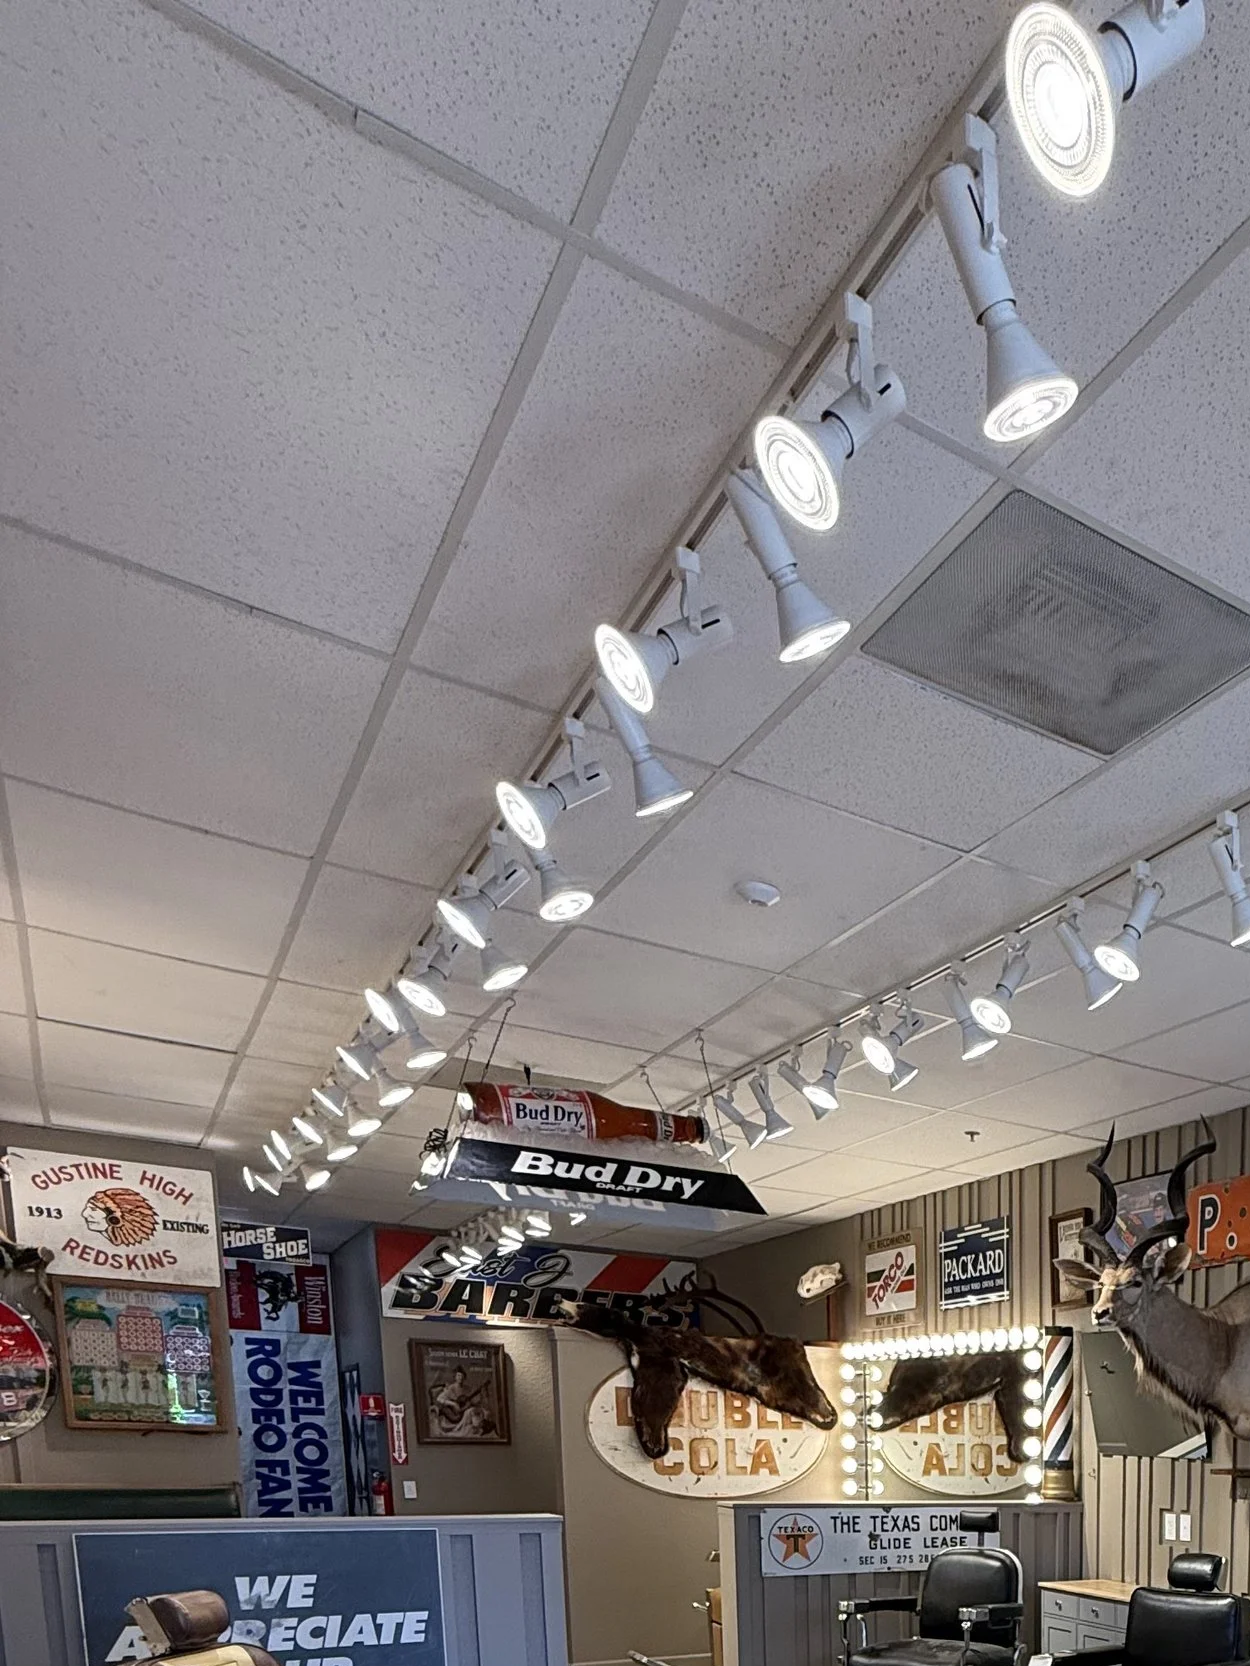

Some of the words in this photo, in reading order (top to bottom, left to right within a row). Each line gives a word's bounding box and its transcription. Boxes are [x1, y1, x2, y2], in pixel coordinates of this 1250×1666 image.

[515, 1102, 549, 1121] Bud
[554, 1105, 583, 1127] Dry
[31, 1162, 123, 1191] GUSTINE
[139, 1170, 194, 1206] HIGH
[510, 1151, 617, 1185] Bud
[624, 1165, 705, 1199] Dry
[595, 1181, 644, 1193] DRAFT
[27, 1205, 63, 1219] 1913
[162, 1219, 210, 1234] EXISTING
[1196, 1193, 1238, 1255] P.
[61, 1237, 178, 1271] REDSKINS
[222, 1226, 276, 1249] HORSE
[262, 1239, 308, 1260] SHOE
[521, 1252, 575, 1289] J
[872, 1251, 904, 1310] TORCO
[944, 1249, 1004, 1282] PACKARD
[304, 1276, 327, 1325] Winston
[244, 1337, 288, 1454] RODEO
[287, 1360, 334, 1514] WELCOME
[653, 1437, 780, 1476] COLA
[777, 1526, 814, 1534] TEXACO
[830, 1515, 861, 1534] THE
[870, 1514, 920, 1533] TEXAS
[868, 1536, 912, 1550] GLIDE
[923, 1536, 968, 1549] LEASE
[859, 1556, 875, 1566] SEC
[234, 1574, 318, 1611] WE
[105, 1610, 429, 1663] ARECIATE
